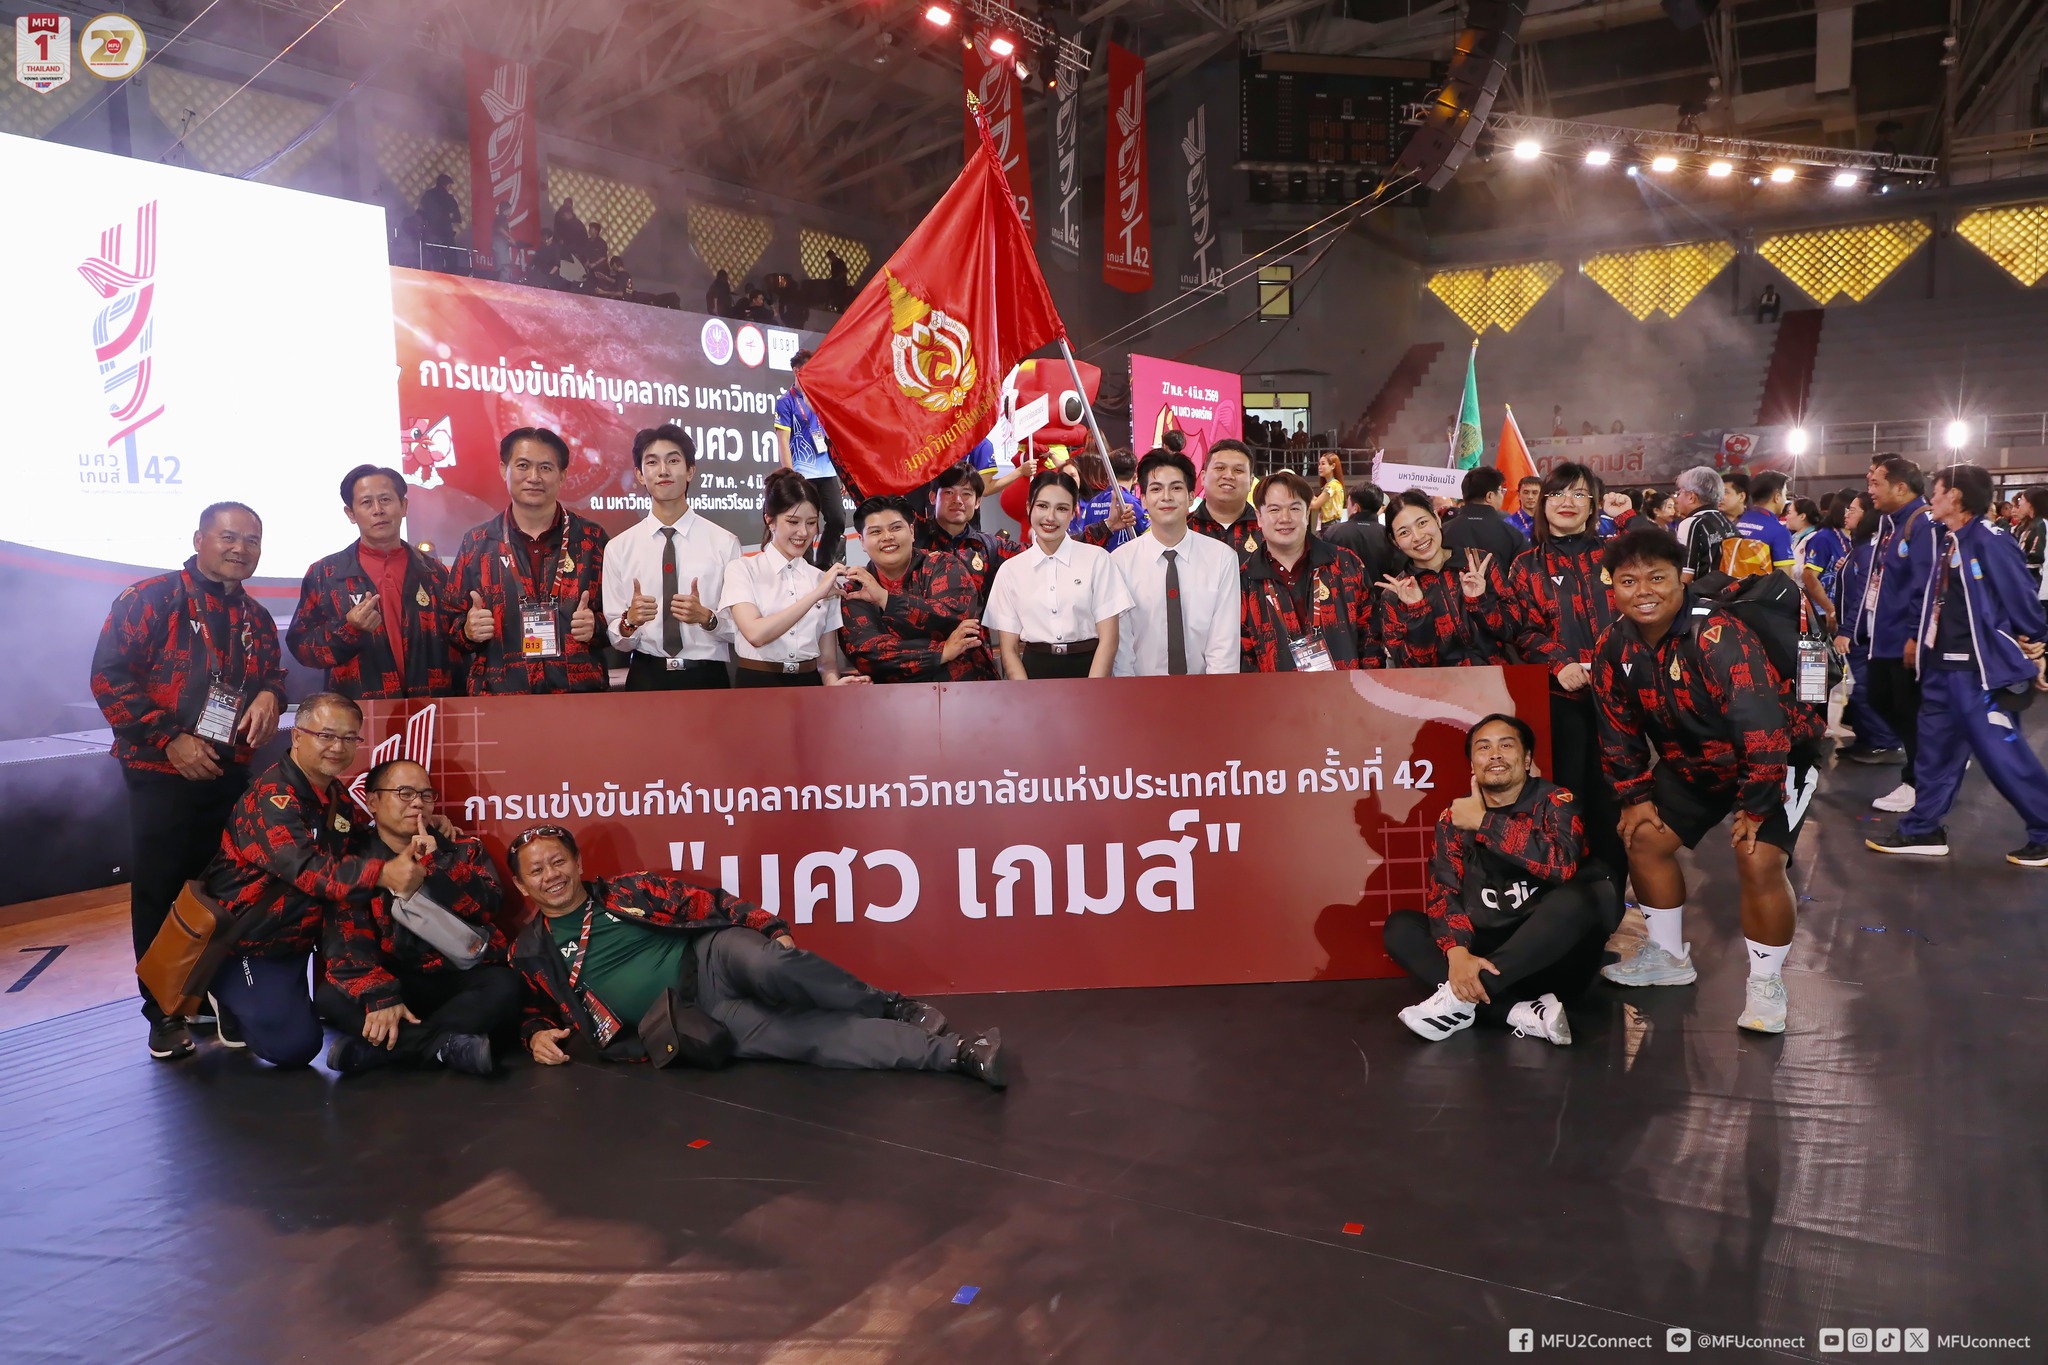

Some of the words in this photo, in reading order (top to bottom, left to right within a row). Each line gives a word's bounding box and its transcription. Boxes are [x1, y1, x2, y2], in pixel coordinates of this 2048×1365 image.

[1133, 246, 1150, 268] 42
[1208, 267, 1224, 288] 42
[419, 356, 690, 414] การแข่งขันกีฬาบุคลากร
[1162, 381, 1170, 395] 27
[79, 453, 119, 467] มศว
[80, 467, 121, 484] เกมส์
[144, 455, 183, 484] 42
[1398, 471, 1456, 485] มหาวิทยาลัยแม่โจ้
[700, 473, 715, 489] 27
[716, 475, 738, 489] พ.ค.
[747, 475, 754, 489] 4
[590, 496, 604, 510] ณ
[525, 642, 541, 650] B13
[464, 760, 1287, 826] การแข่งขันกีฬาบุคลากรมหาวิทยาลัยแห่งประเทศไทย
[1298, 746, 1384, 794] ครั้งที่
[1392, 759, 1435, 791] 42
[957, 808, 1241, 919] เกมส์"
